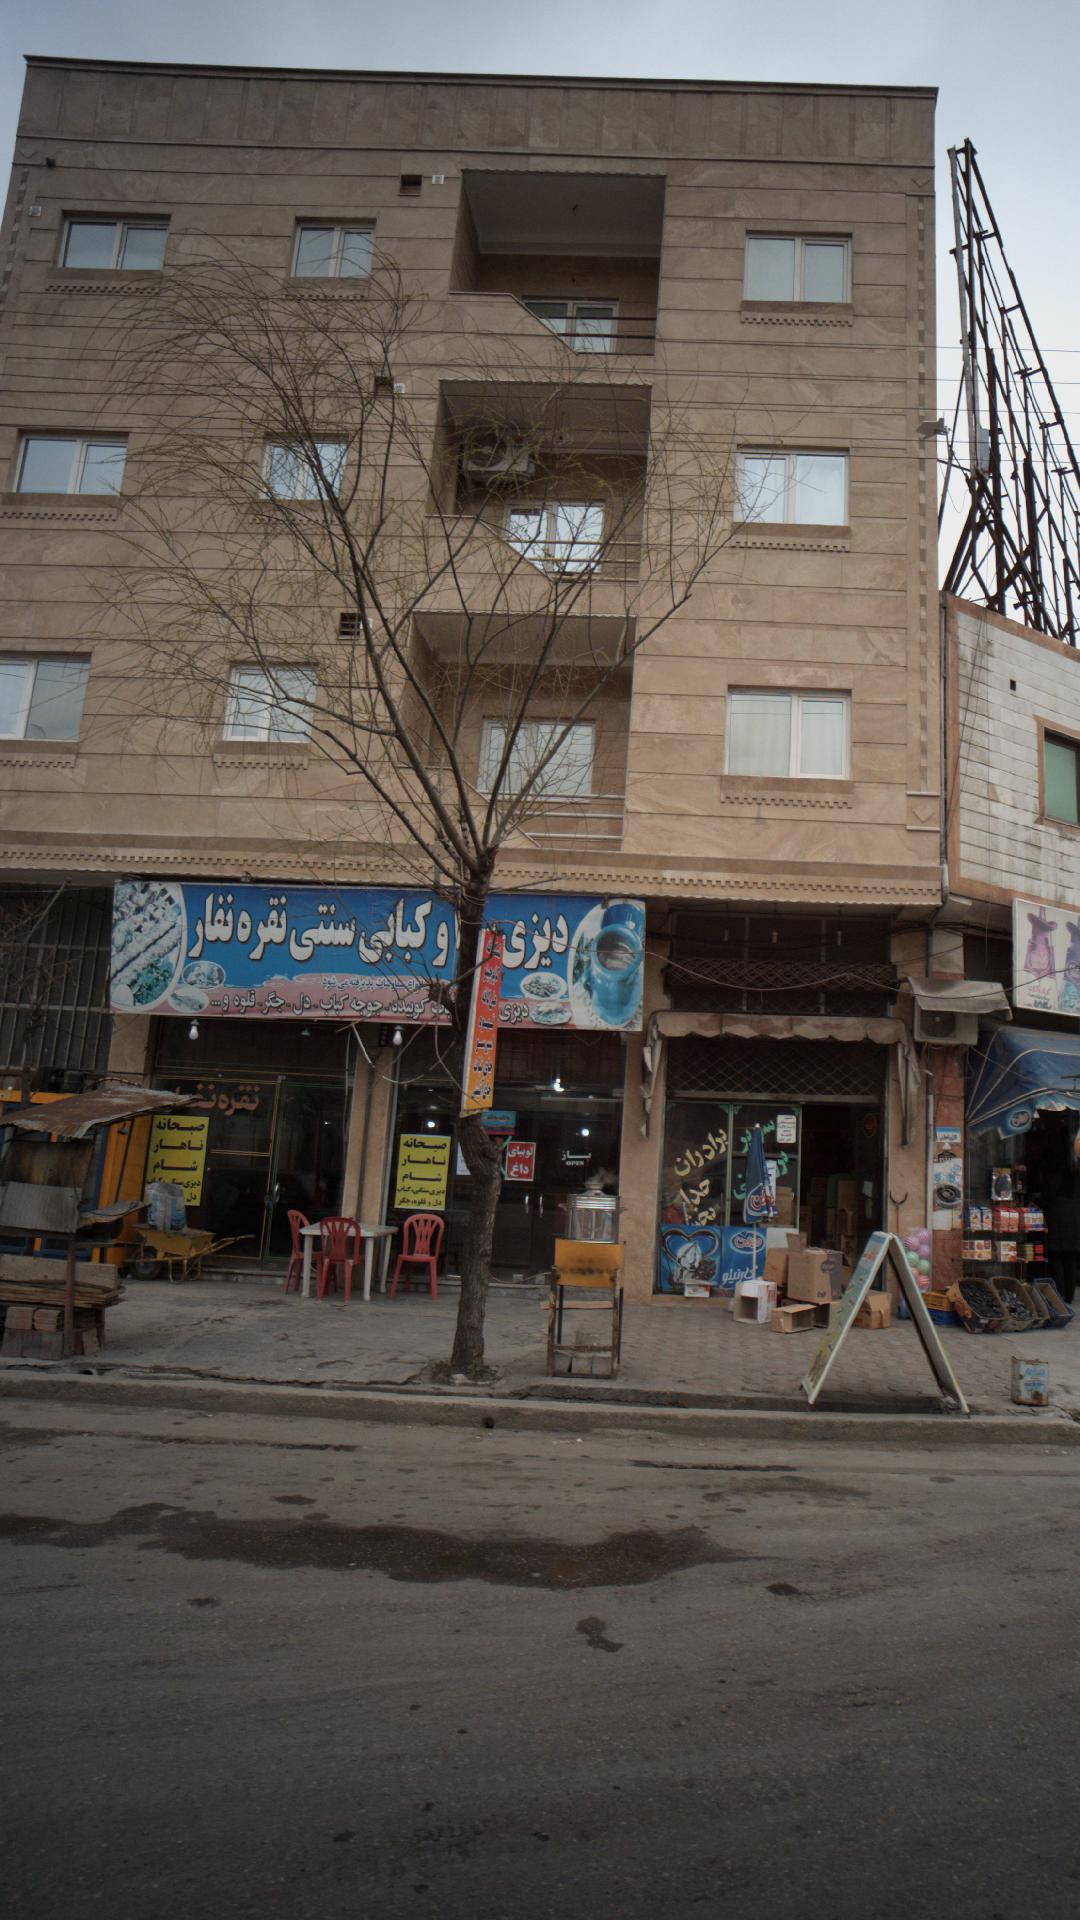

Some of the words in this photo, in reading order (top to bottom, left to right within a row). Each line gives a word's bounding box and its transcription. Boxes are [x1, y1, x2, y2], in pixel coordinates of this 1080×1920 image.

[236, 896, 287, 960] نقره
[290, 904, 357, 962] سنتی
[358, 898, 432, 964] کبابی
[432, 921, 449, 967] و
[502, 913, 569, 969] دیزی
[233, 990, 256, 1014] قلوه
[261, 990, 286, 1014] جگر
[292, 992, 312, 1015] دل
[320, 994, 350, 1015] کباب
[350, 997, 383, 1017] جوجه
[499, 1002, 529, 1024] دیزی
[156, 1118, 205, 1135] صبحانه
[153, 1138, 204, 1153] ناهار
[402, 1137, 448, 1153] صبحانه
[508, 1145, 534, 1159] لوبیای
[674, 1127, 729, 1177] برادران
[152, 1159, 198, 1174] شام
[400, 1154, 446, 1167] ناهار
[510, 1161, 530, 1177] داغ
[401, 1171, 442, 1183] شام
